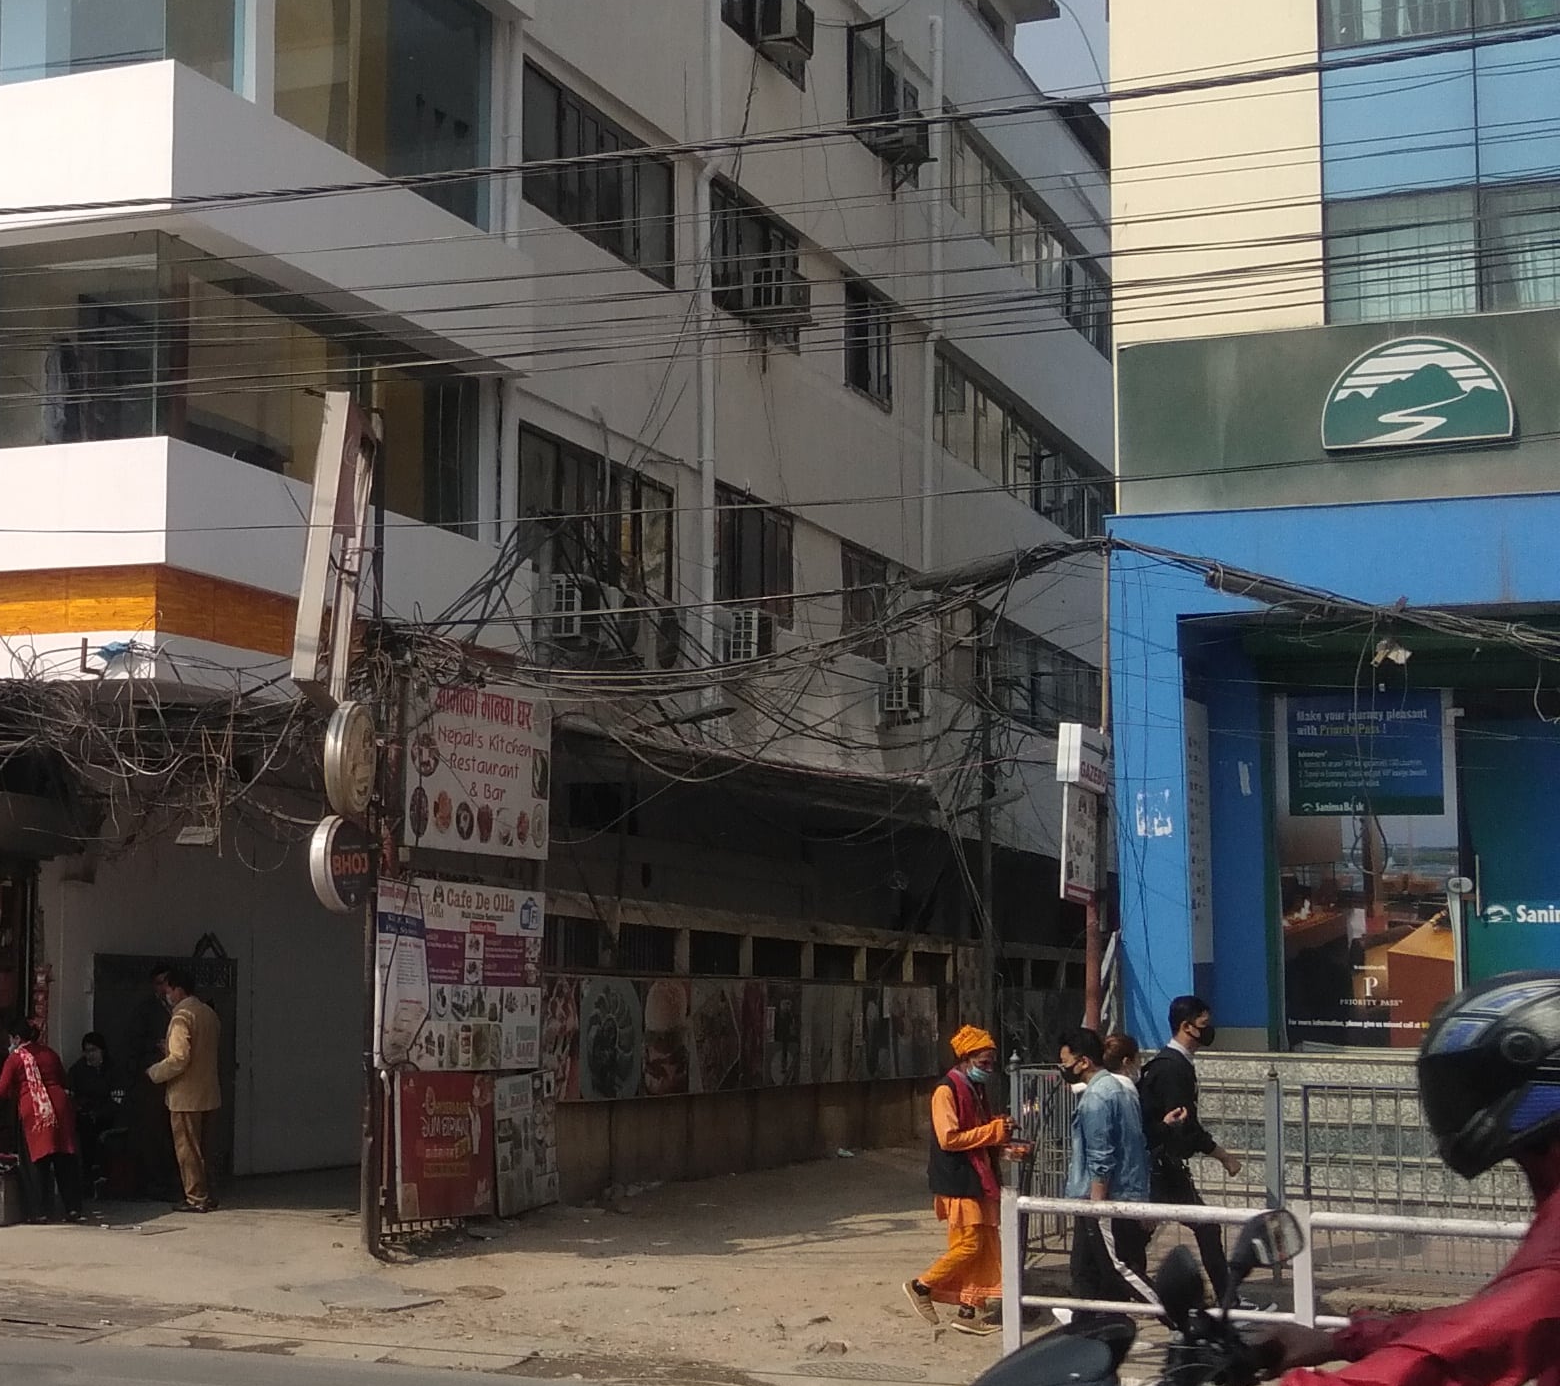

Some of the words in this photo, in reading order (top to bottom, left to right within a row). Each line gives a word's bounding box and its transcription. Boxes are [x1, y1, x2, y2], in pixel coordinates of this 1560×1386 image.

[1296, 711, 1321, 722] Make
[1324, 712, 1345, 723] your
[1347, 709, 1384, 723] journey
[1386, 709, 1428, 722] pleasant
[1296, 725, 1317, 735] with
[438, 725, 484, 752] Nepal's
[489, 734, 532, 758] Kitchen
[449, 753, 520, 780] Restaurant
[468, 781, 478, 798] &
[484, 783, 506, 802] Bar
[1314, 802, 1343, 812] Sanima
[332, 852, 369, 877] BHOJ
[446, 888, 472, 910] Cafe
[475, 892, 490, 911] De
[493, 894, 515, 913] Olla
[1363, 976, 1379, 997] P
[1339, 999, 1377, 1007] PRIORITY
